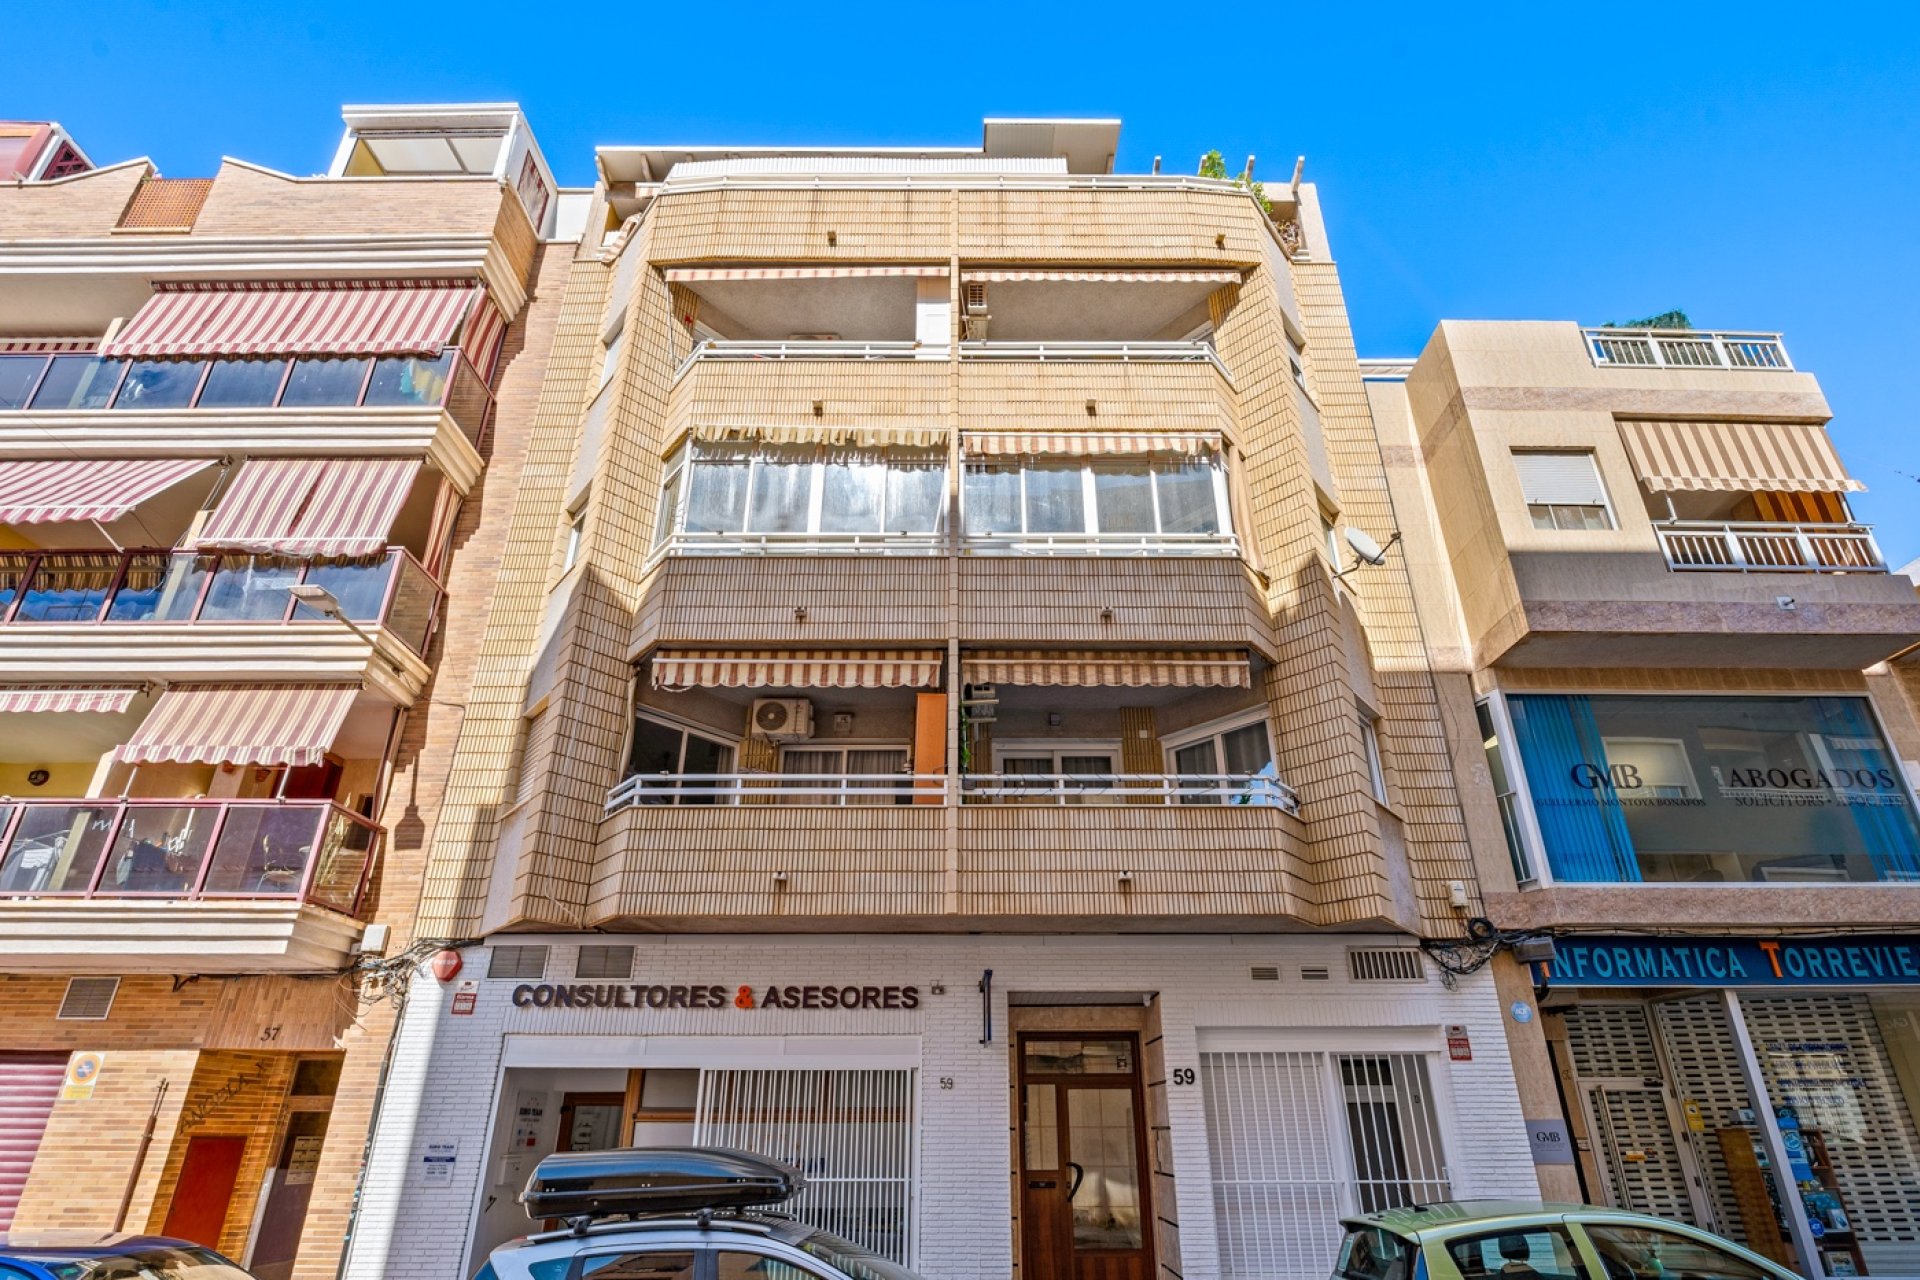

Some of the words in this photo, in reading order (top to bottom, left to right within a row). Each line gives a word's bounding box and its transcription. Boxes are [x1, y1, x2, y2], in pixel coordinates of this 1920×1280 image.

[1570, 763, 1643, 790] GMB
[1729, 767, 1896, 789] ABOGADOS
[1735, 794, 1825, 807] SOLICITORS
[512, 984, 728, 1008] CONSULTORES
[734, 985, 754, 1009] &
[761, 985, 919, 1009] ASESORES
[261, 1026, 280, 1041] 57
[940, 1077, 953, 1090] 59
[1173, 1068, 1195, 1086] 59
[1536, 1131, 1561, 1142] GMB
